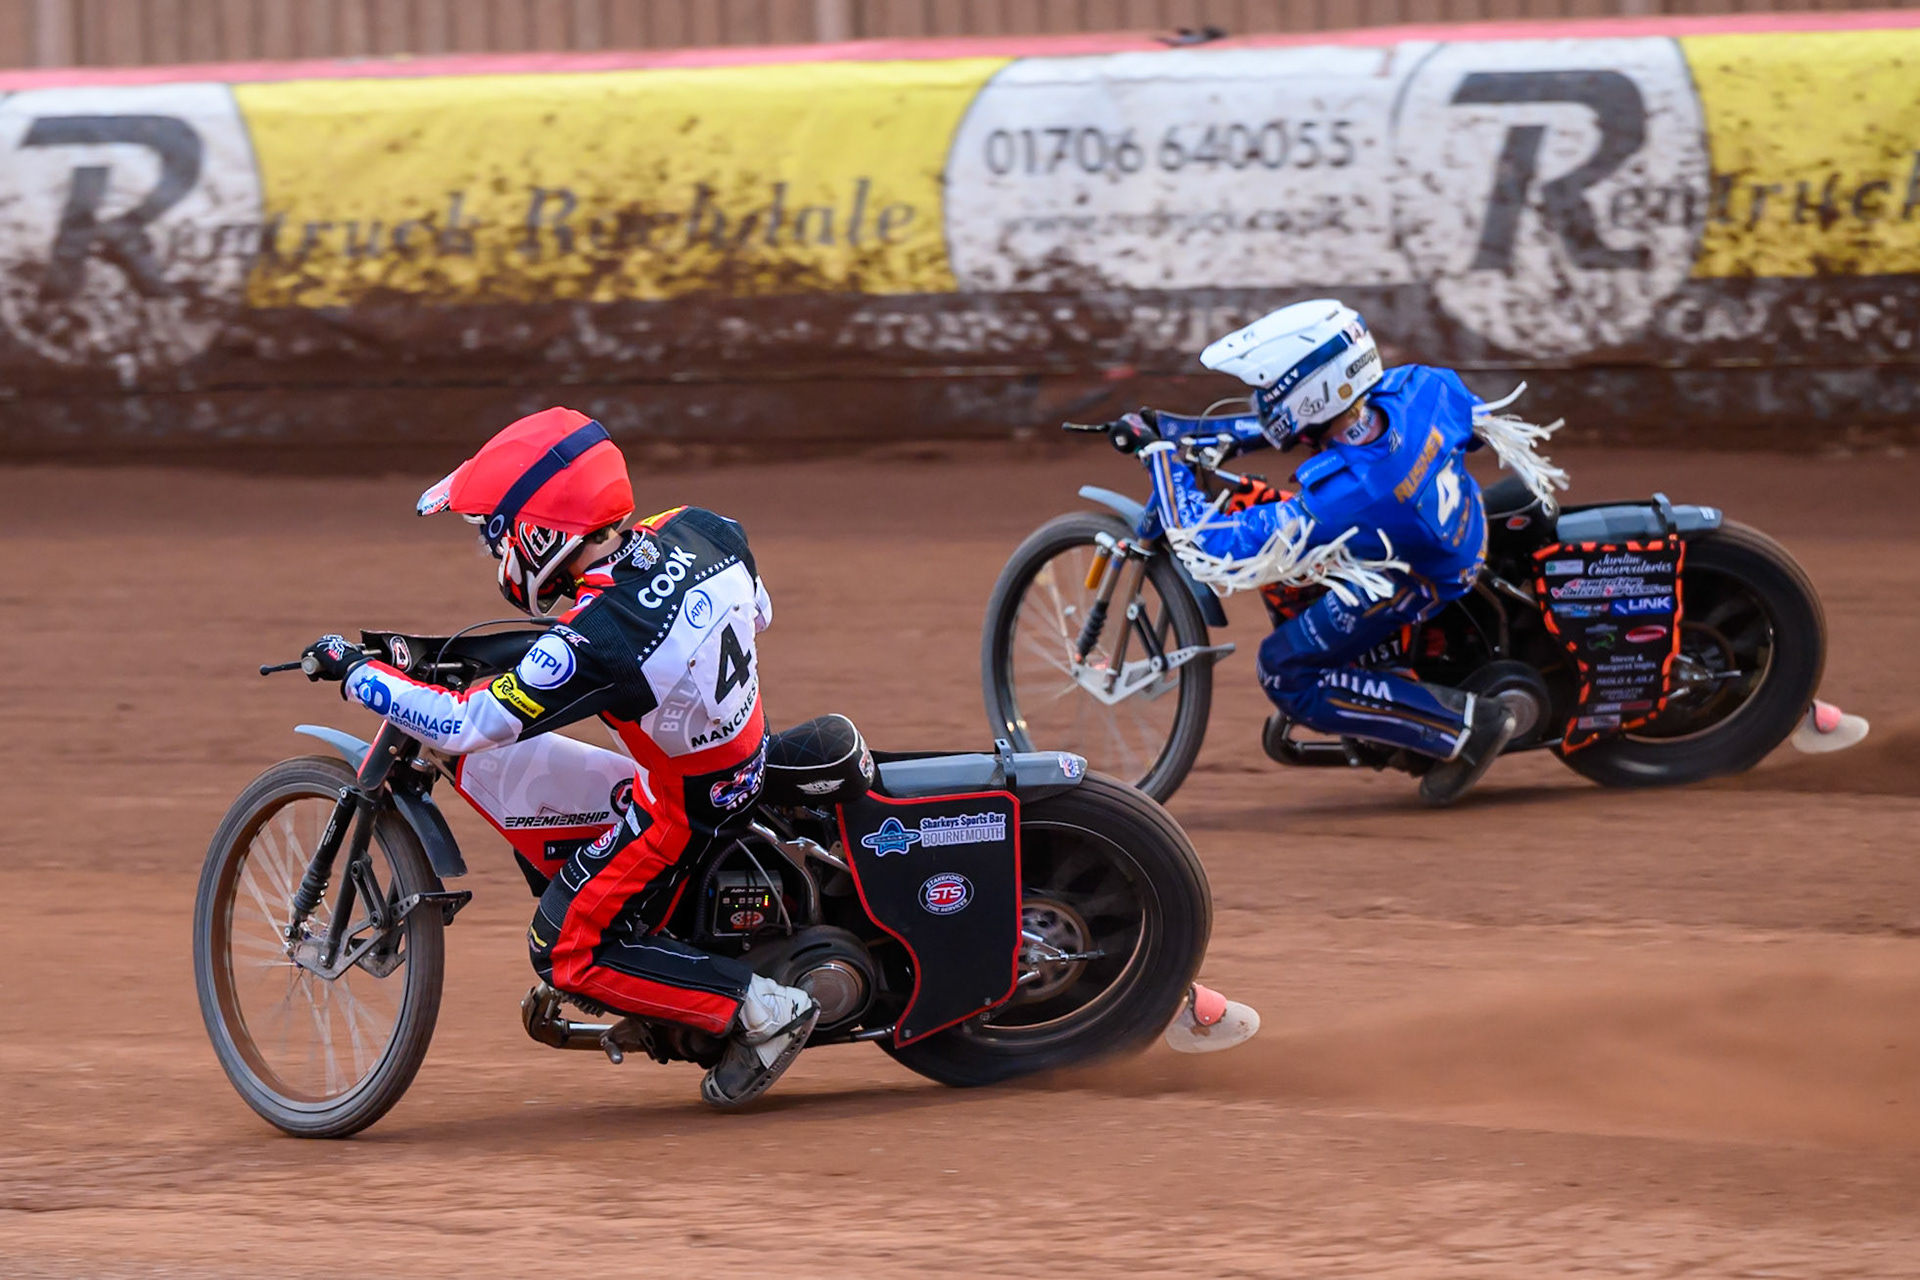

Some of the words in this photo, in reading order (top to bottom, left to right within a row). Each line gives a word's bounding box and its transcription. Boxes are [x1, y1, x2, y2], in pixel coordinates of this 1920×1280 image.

[985, 126, 1143, 177] 01706
[1158, 119, 1357, 173] 640055
[637, 545, 697, 609] COOK
[690, 597, 707, 621] ATPI
[1629, 597, 1672, 611] LINK
[526, 647, 562, 675] ATPI
[714, 622, 752, 705] 4
[690, 674, 760, 748] MANCHES
[511, 811, 611, 829] PREMIERSHIP
[921, 818, 960, 830] Sharkeys
[960, 815, 988, 827] Sports
[989, 813, 1005, 823] Bar
[922, 827, 1005, 845] BOURNEMOUTH
[928, 886, 962, 901] STS
